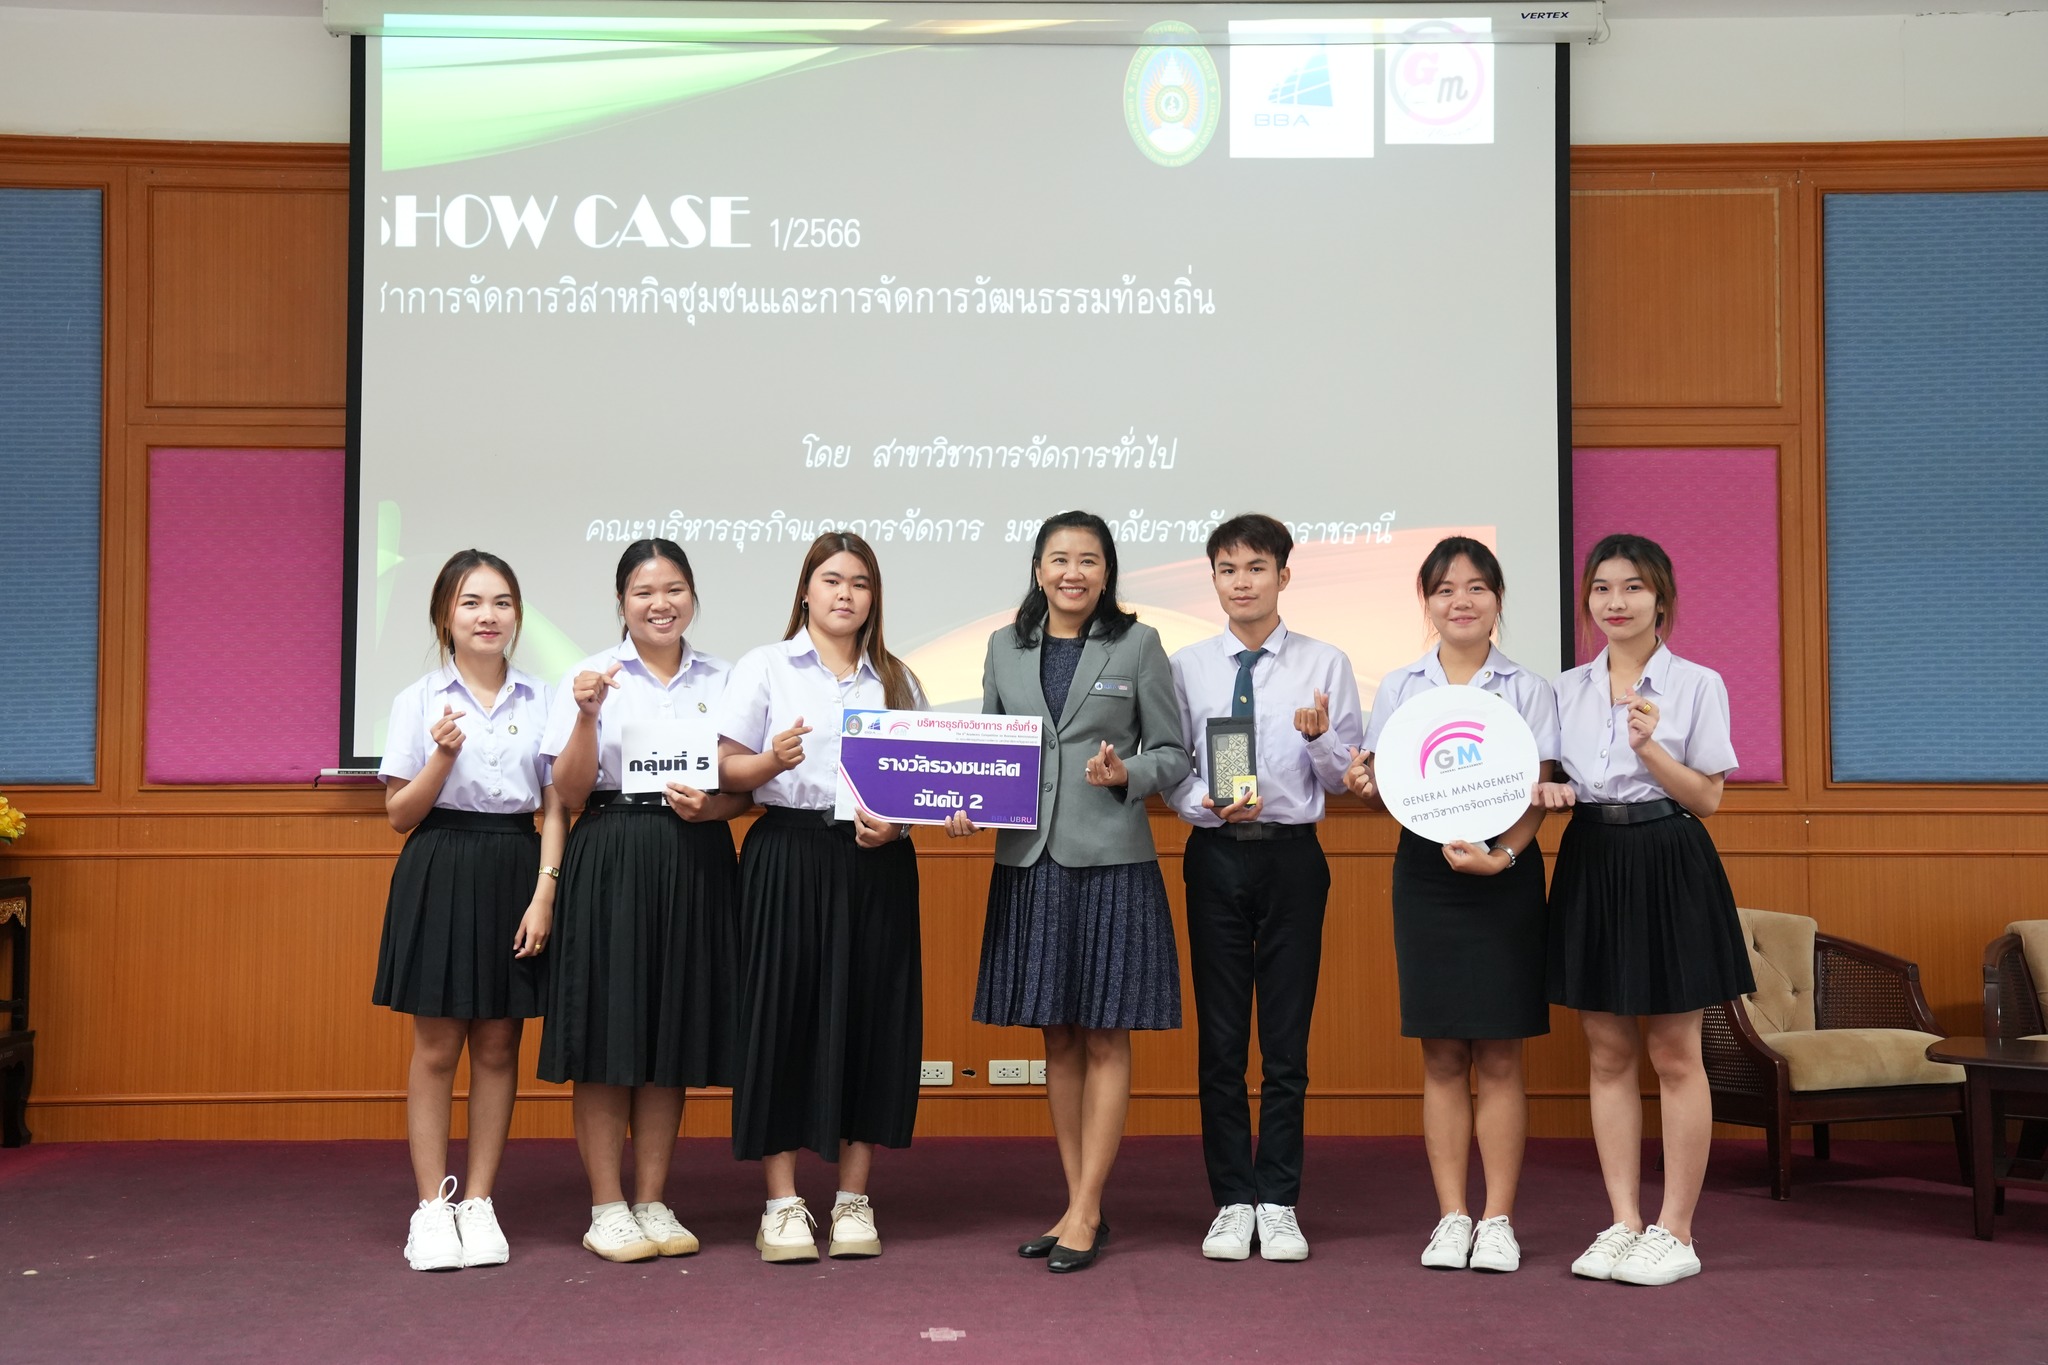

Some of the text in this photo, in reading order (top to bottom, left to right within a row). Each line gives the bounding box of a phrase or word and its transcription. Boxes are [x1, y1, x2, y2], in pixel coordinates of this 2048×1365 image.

[1521, 11, 1569, 20] VERTEX
[1254, 113, 1310, 127] BBA
[573, 194, 752, 249] CASE
[769, 217, 862, 252] 1/2566
[802, 426, 1178, 470] โดย สาขาวิชาการจัดการทั่วไป
[917, 717, 1003, 733] บริหารธุรกิจวิชาการ
[629, 751, 710, 776] กลุ่มที่ 5
[878, 754, 1021, 777] รางวัลรองชนะเลิศ
[1434, 743, 1482, 770] GM
[914, 788, 984, 810] อันดับ 2
[1402, 772, 1525, 807] GENERAL MANAGEMENT
[1411, 788, 1526, 823] สาขาวิชาการจัดการทั่วไป
